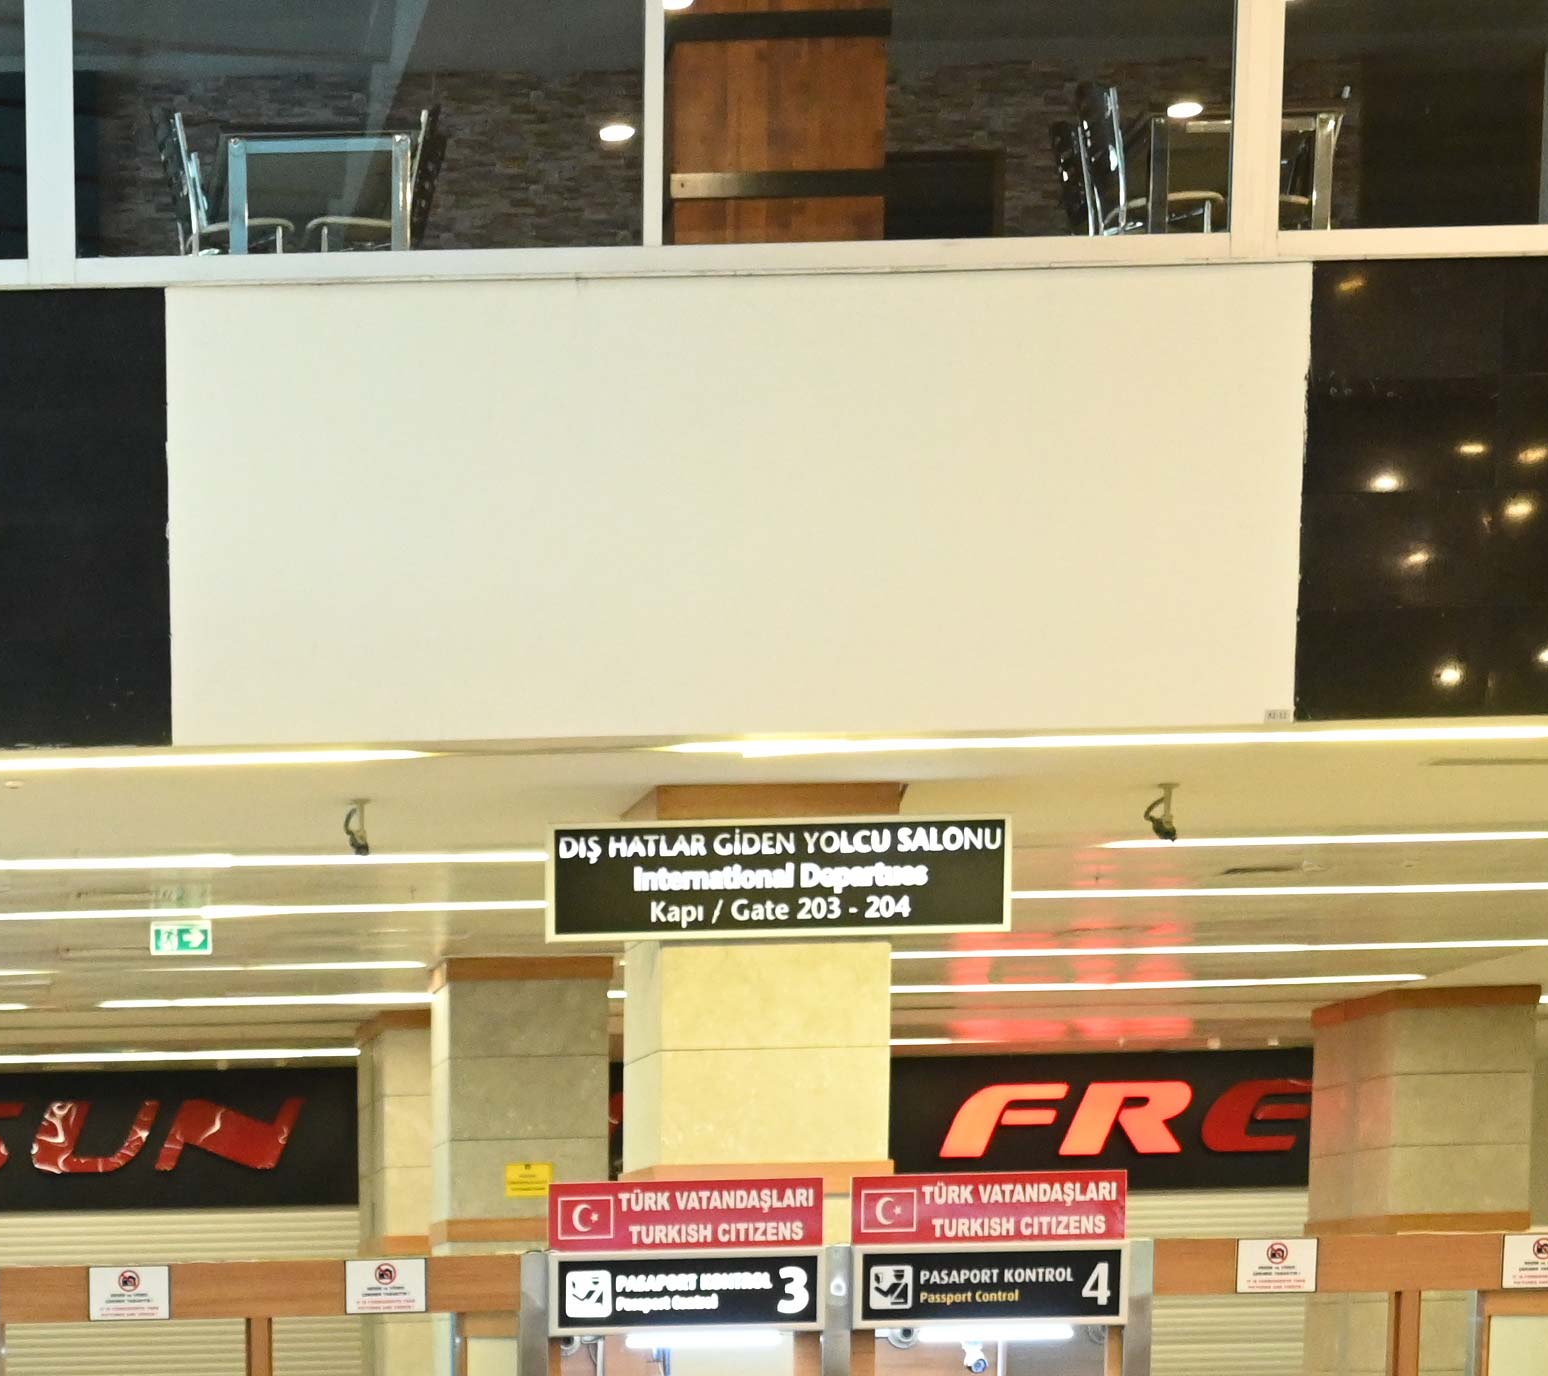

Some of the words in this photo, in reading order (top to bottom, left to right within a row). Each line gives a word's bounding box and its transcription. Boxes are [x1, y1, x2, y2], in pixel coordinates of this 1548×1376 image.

[559, 836, 601, 864] DIŞ
[608, 834, 706, 857] HATLAR
[713, 828, 795, 855] GİDEN
[804, 828, 891, 853] YOLCU
[897, 826, 1002, 851] SALONU
[634, 862, 794, 891] International
[651, 900, 704, 928] Kapı
[712, 899, 723, 924] /
[731, 899, 789, 920] Gate
[797, 896, 841, 919] 203
[865, 895, 911, 918] 204
[618, 1190, 670, 1211] TÜRK
[675, 1189, 814, 1213] VATANDAŞLARI
[922, 1182, 973, 1205] TÜRK
[979, 1182, 1117, 1206] VATANDAŞLARI
[629, 1224, 712, 1244] TURKISH
[717, 1222, 804, 1241] CITIZENS
[932, 1217, 1014, 1237] TURKISH
[1020, 1215, 1106, 1236] CITIZENS
[777, 1266, 809, 1314] 3
[920, 1269, 999, 1284] PASAPORT
[1004, 1267, 1073, 1283] KONTROL
[1081, 1262, 1110, 1305] 4
[920, 1291, 971, 1305] Passport
[975, 1289, 1019, 1302] Control
